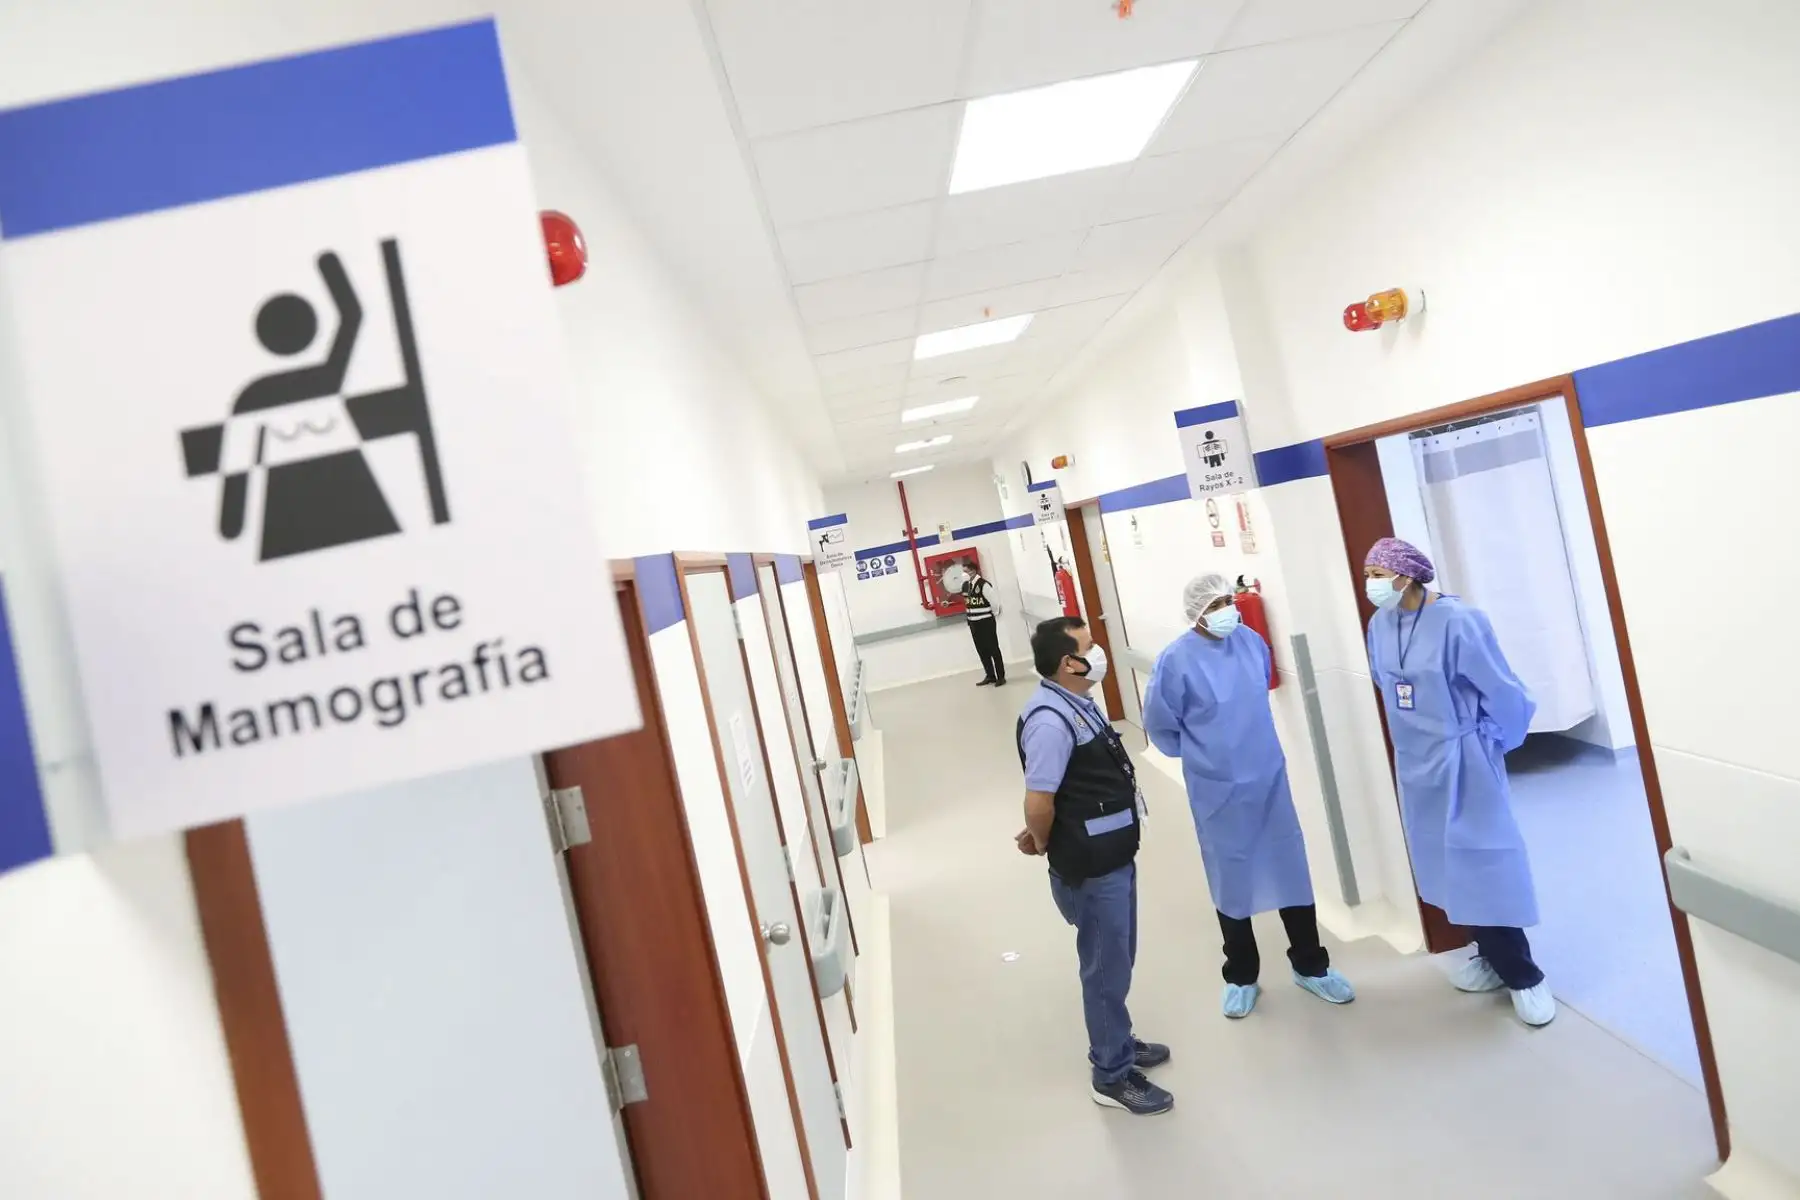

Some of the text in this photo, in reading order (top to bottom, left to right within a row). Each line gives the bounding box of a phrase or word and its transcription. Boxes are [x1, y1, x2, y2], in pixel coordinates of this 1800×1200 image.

[1199, 482, 1225, 492] Rayos
[1238, 476, 1243, 484] 2
[1204, 473, 1222, 482] Sala
[228, 588, 462, 673] Sala de
[168, 638, 550, 757] Mamografía
